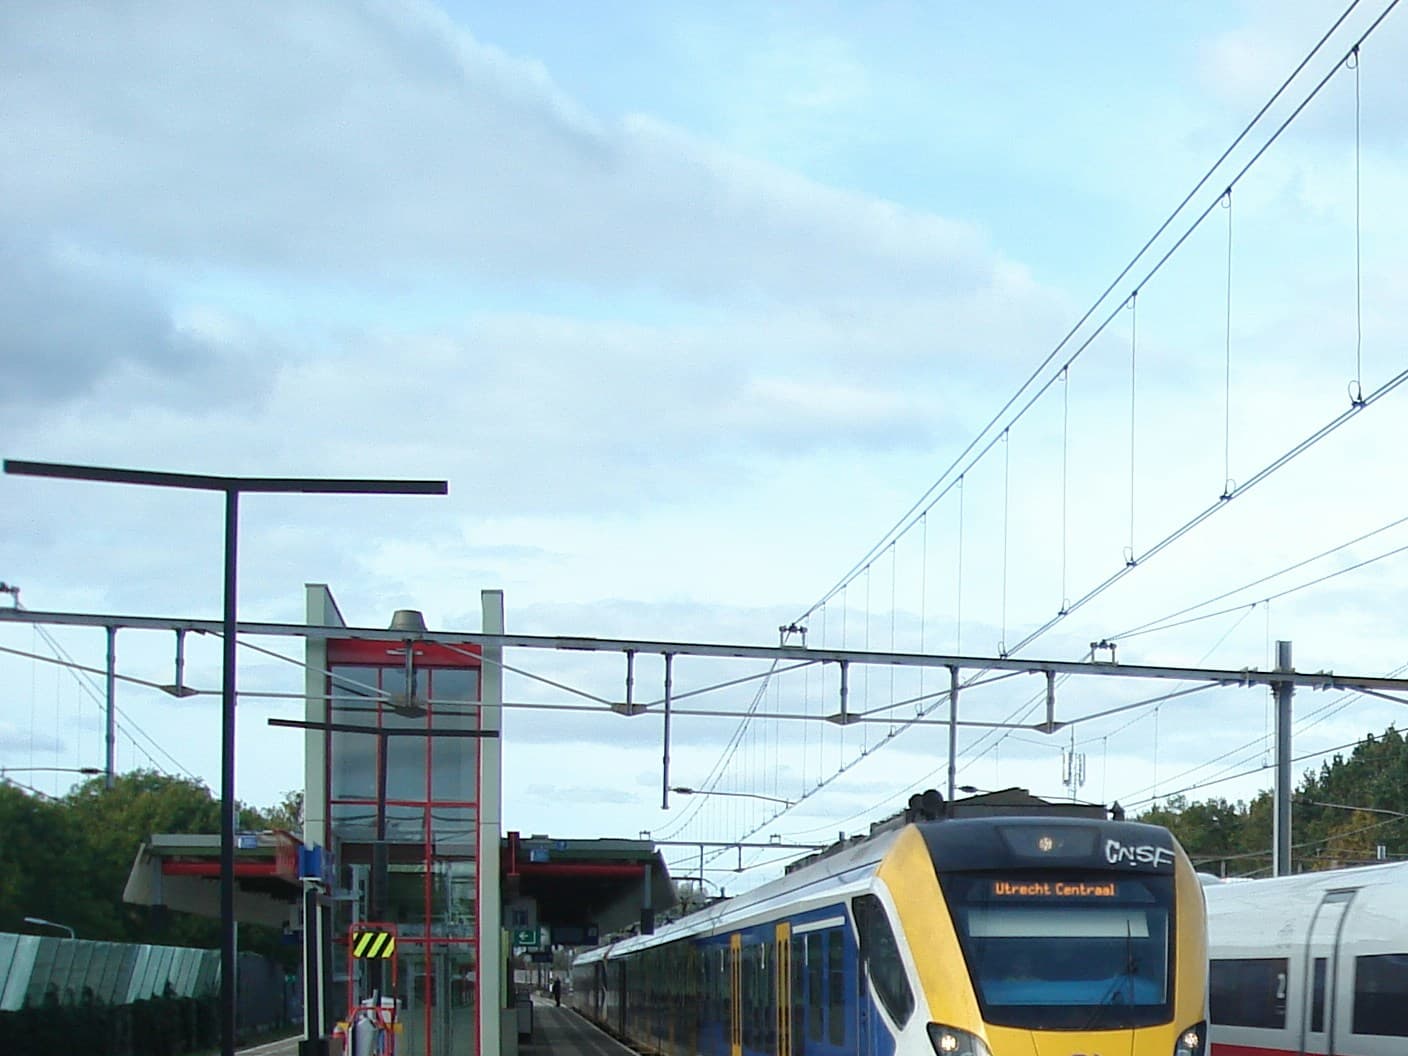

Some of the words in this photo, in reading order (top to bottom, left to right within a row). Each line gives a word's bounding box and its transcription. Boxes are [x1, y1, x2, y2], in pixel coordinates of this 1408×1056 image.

[995, 882, 1051, 896] Utrecht
[1055, 883, 1116, 897] Centraal
[1276, 973, 1286, 999] 2
